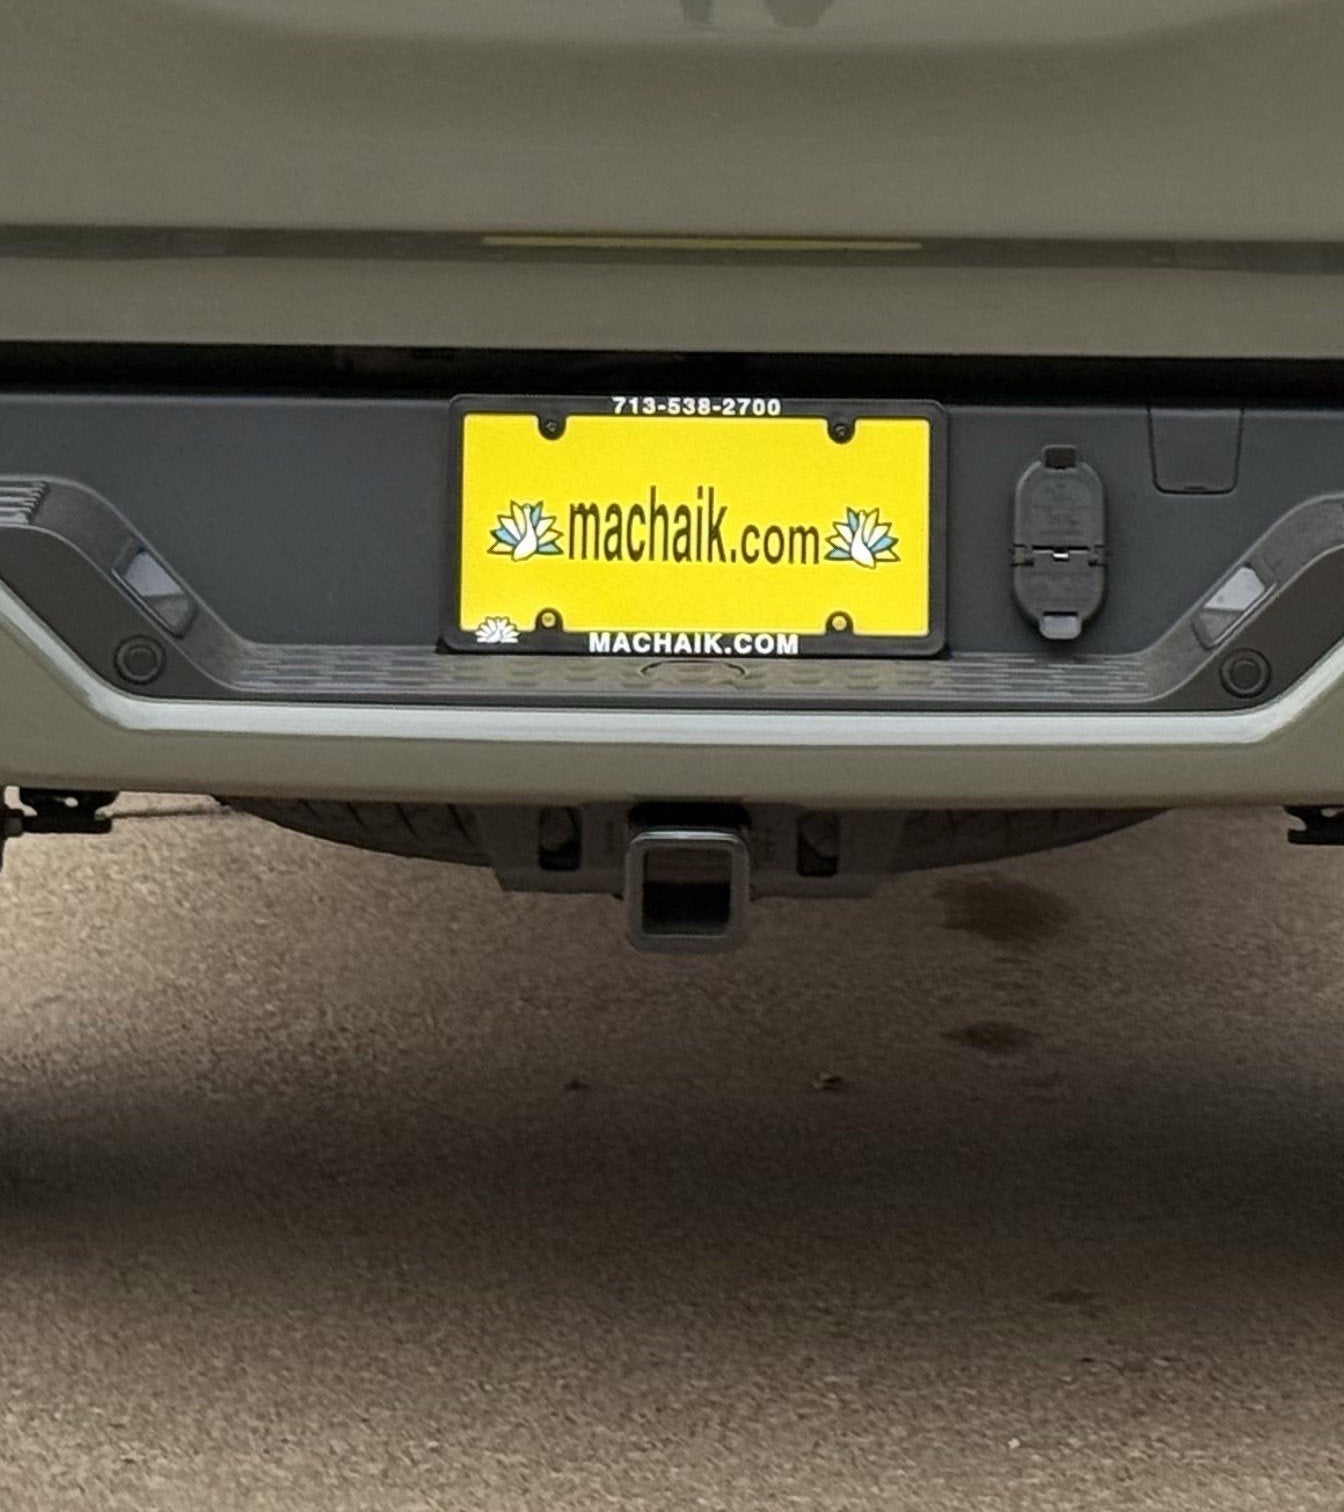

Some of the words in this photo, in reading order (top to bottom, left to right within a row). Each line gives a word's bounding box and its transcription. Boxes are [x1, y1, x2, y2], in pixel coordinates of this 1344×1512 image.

[612, 396, 781, 416] 713-538-2700
[568, 485, 820, 565] machaik.com
[588, 631, 800, 655] MACHAIK.COM
